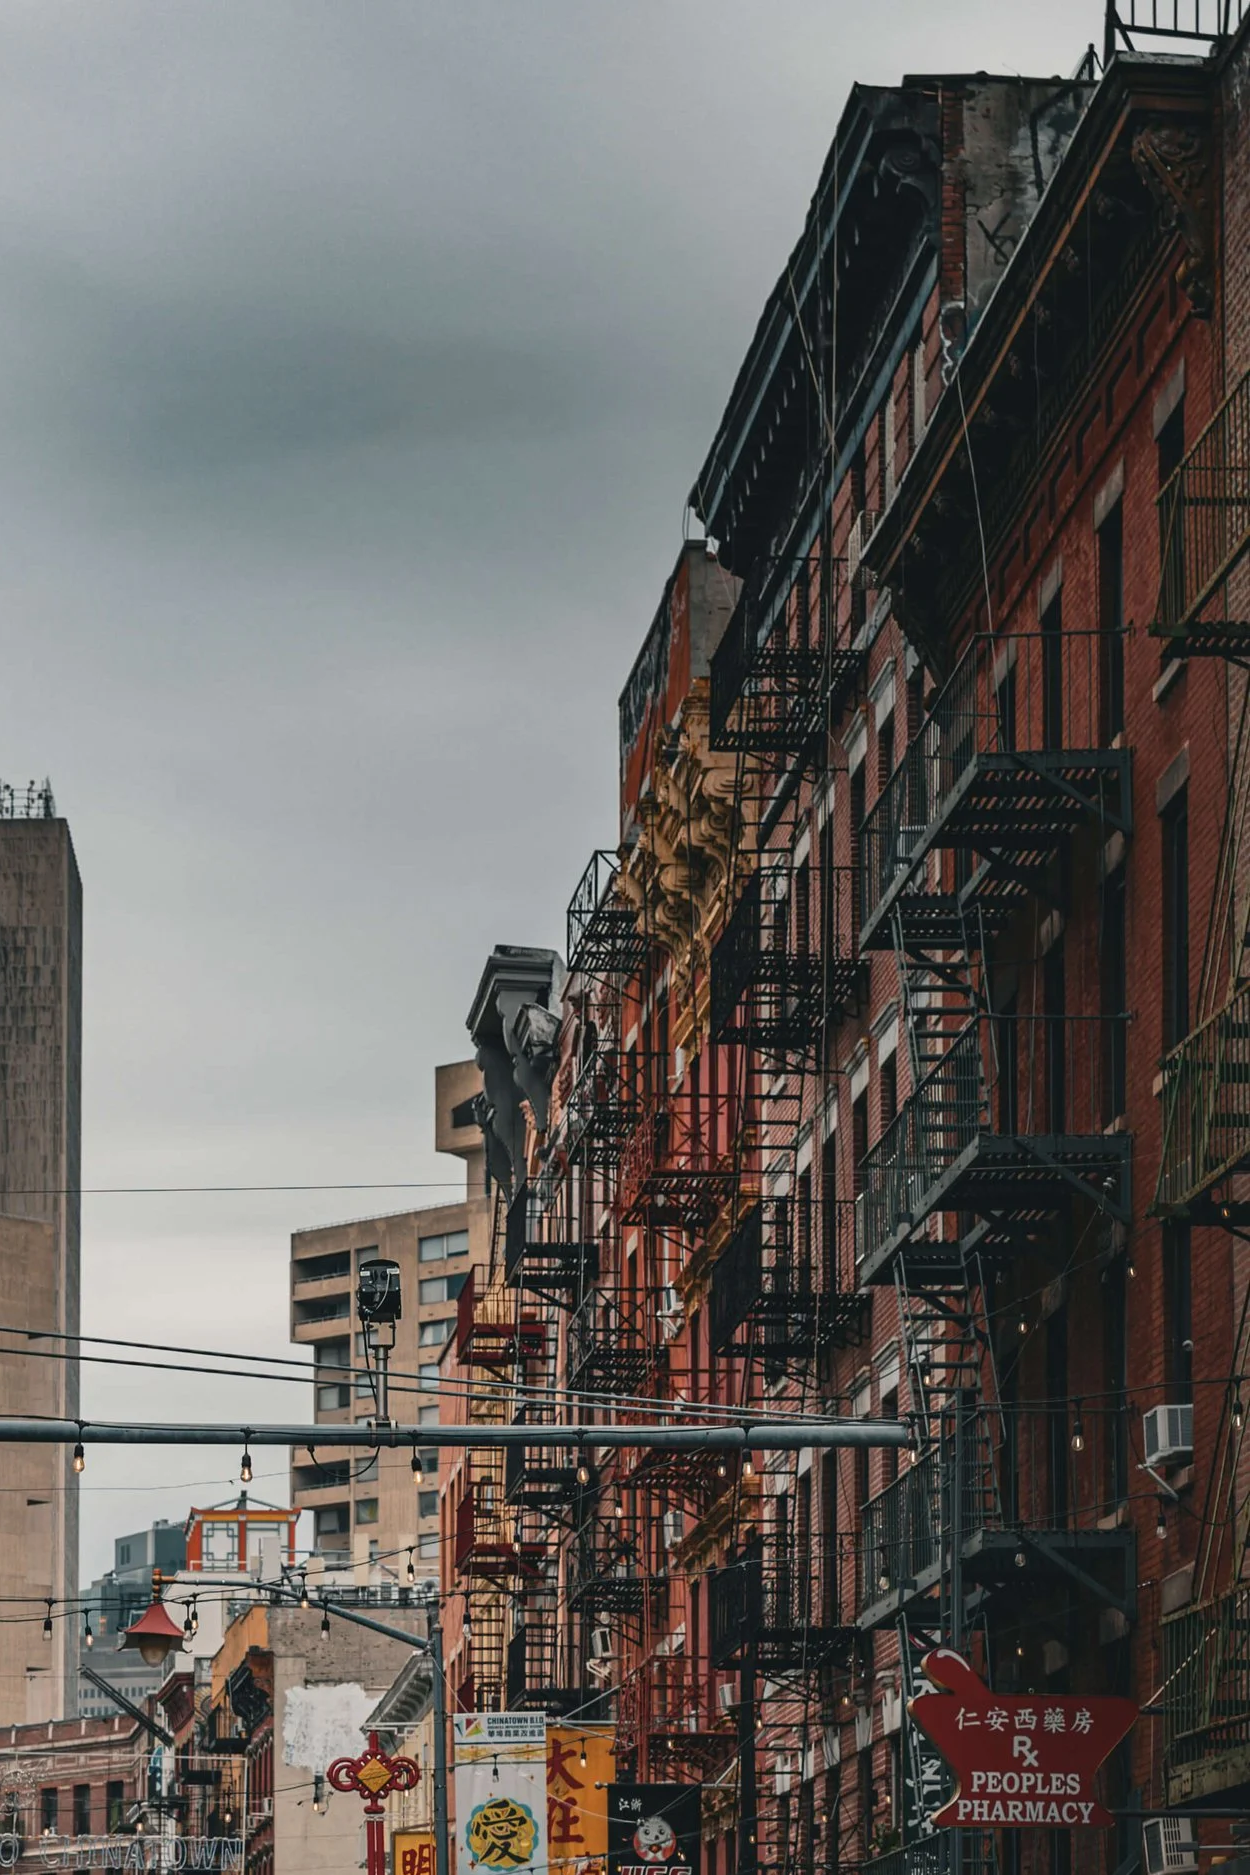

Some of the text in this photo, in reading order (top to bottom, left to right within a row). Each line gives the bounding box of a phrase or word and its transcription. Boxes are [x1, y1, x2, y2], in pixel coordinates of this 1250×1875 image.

[955, 1707, 1094, 1734] 仁安西藥房
[971, 1771, 1081, 1795] PEOPLES
[957, 1800, 1095, 1824] PHARMACY
[472, 1799, 530, 1864] 愛
[40, 1834, 242, 1871] CHINATOWN
